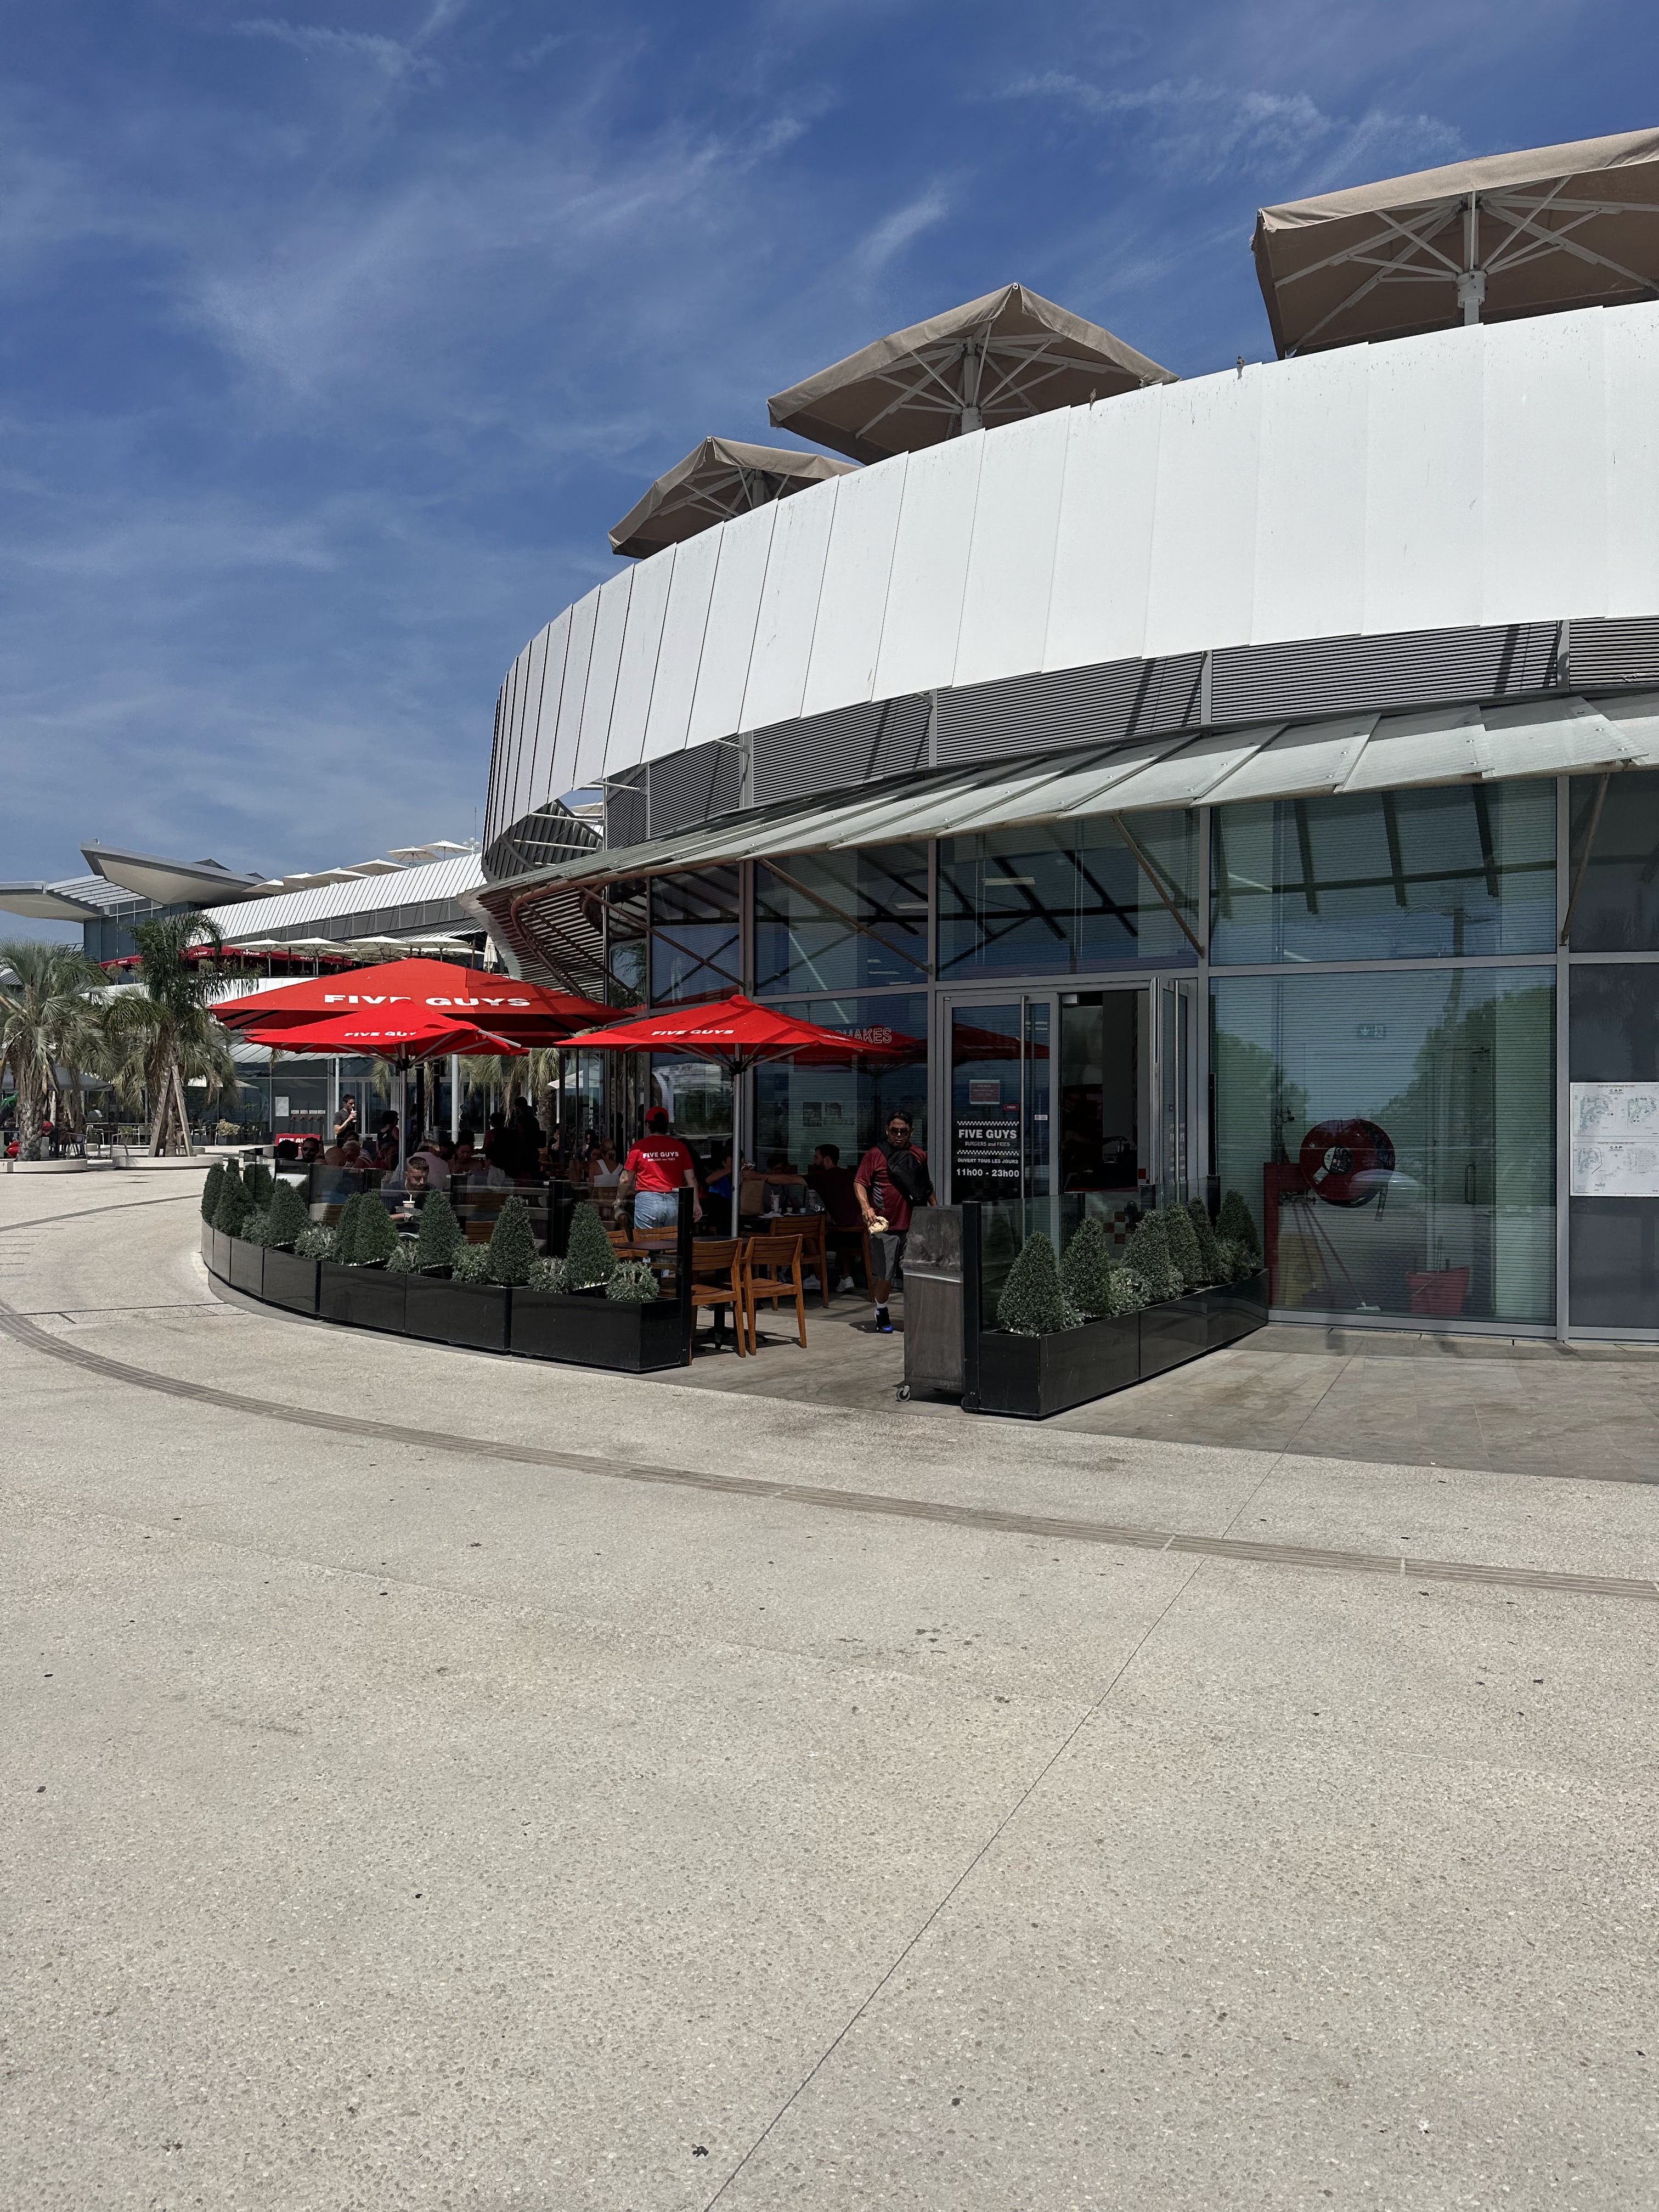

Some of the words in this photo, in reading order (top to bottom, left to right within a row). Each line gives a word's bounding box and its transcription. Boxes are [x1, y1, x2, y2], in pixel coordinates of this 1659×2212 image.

[425, 997, 531, 1007] GUYS
[958, 1129, 983, 1138] FIVE
[986, 1129, 1017, 1138] GUYS
